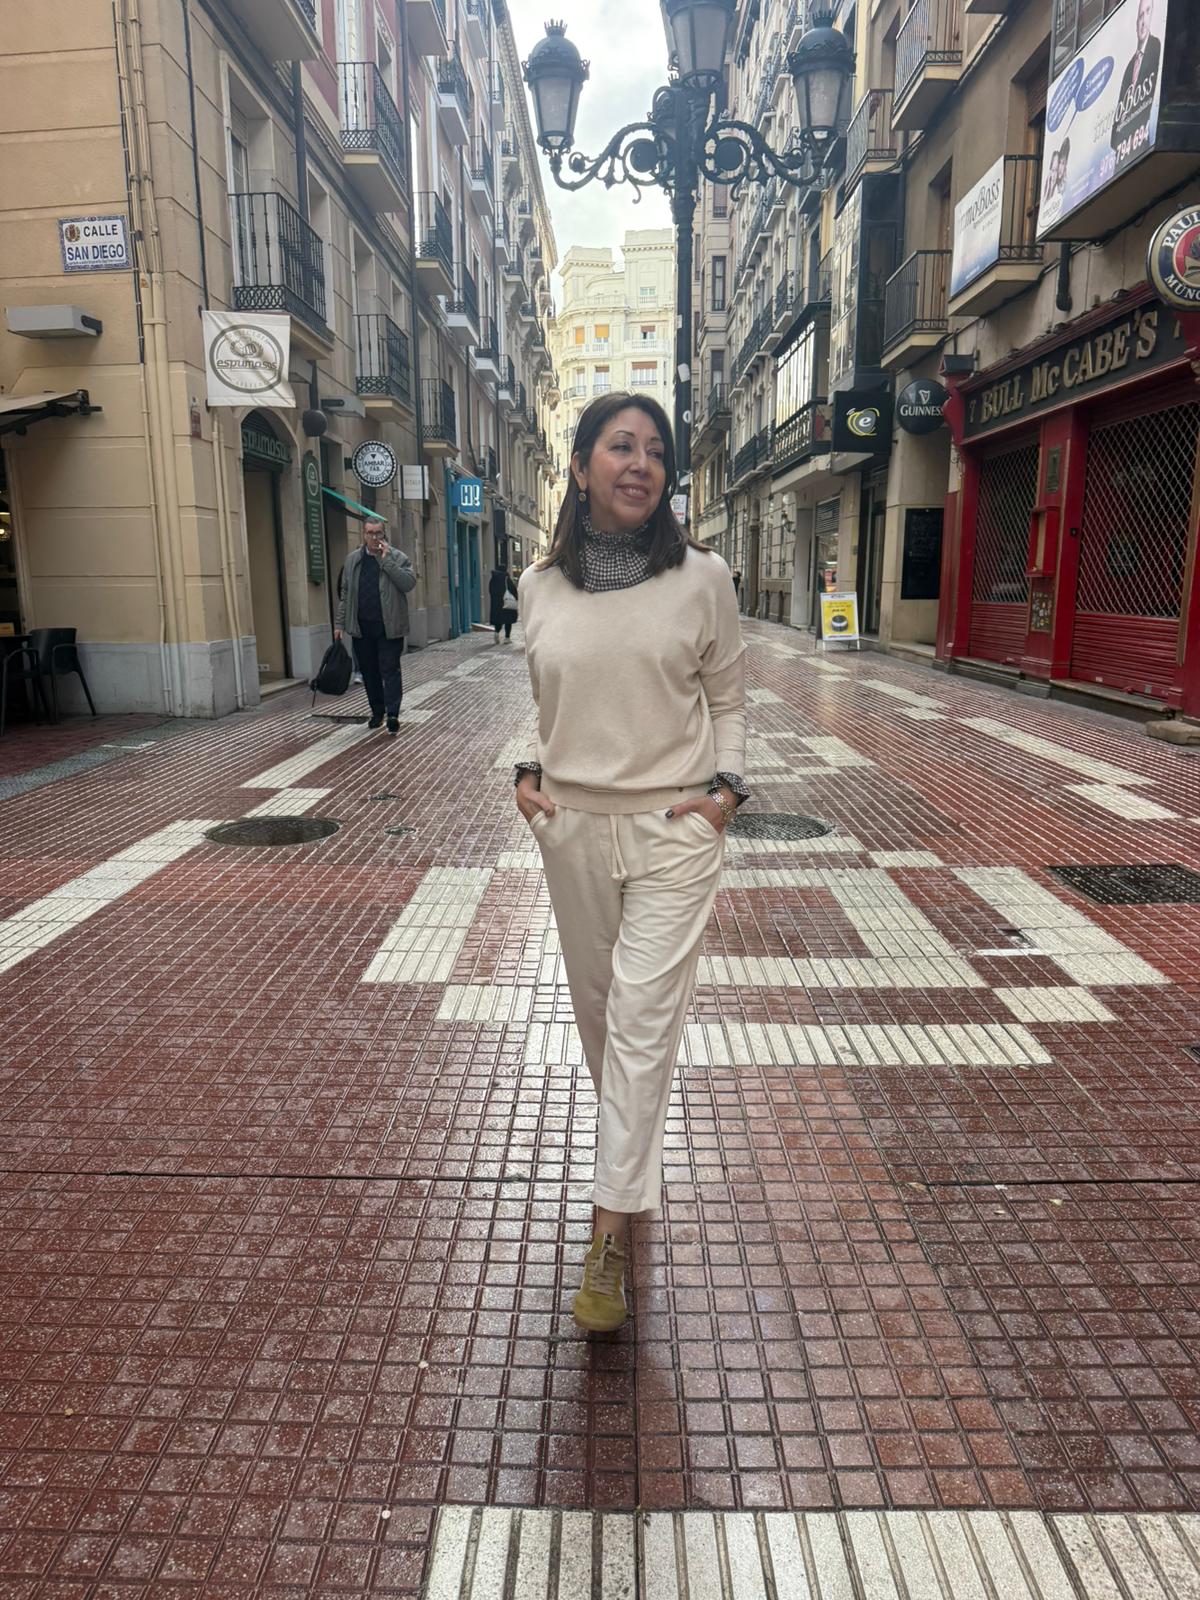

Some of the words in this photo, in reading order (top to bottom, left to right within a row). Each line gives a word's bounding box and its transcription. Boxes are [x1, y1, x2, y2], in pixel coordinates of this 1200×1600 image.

[1116, 134, 1132, 164] 794
[1132, 120, 1150, 150] 694
[83, 224, 118, 237] CALLE
[67, 246, 89, 261] SAN
[92, 244, 124, 259] DIEGO
[980, 375, 1024, 424] BULL
